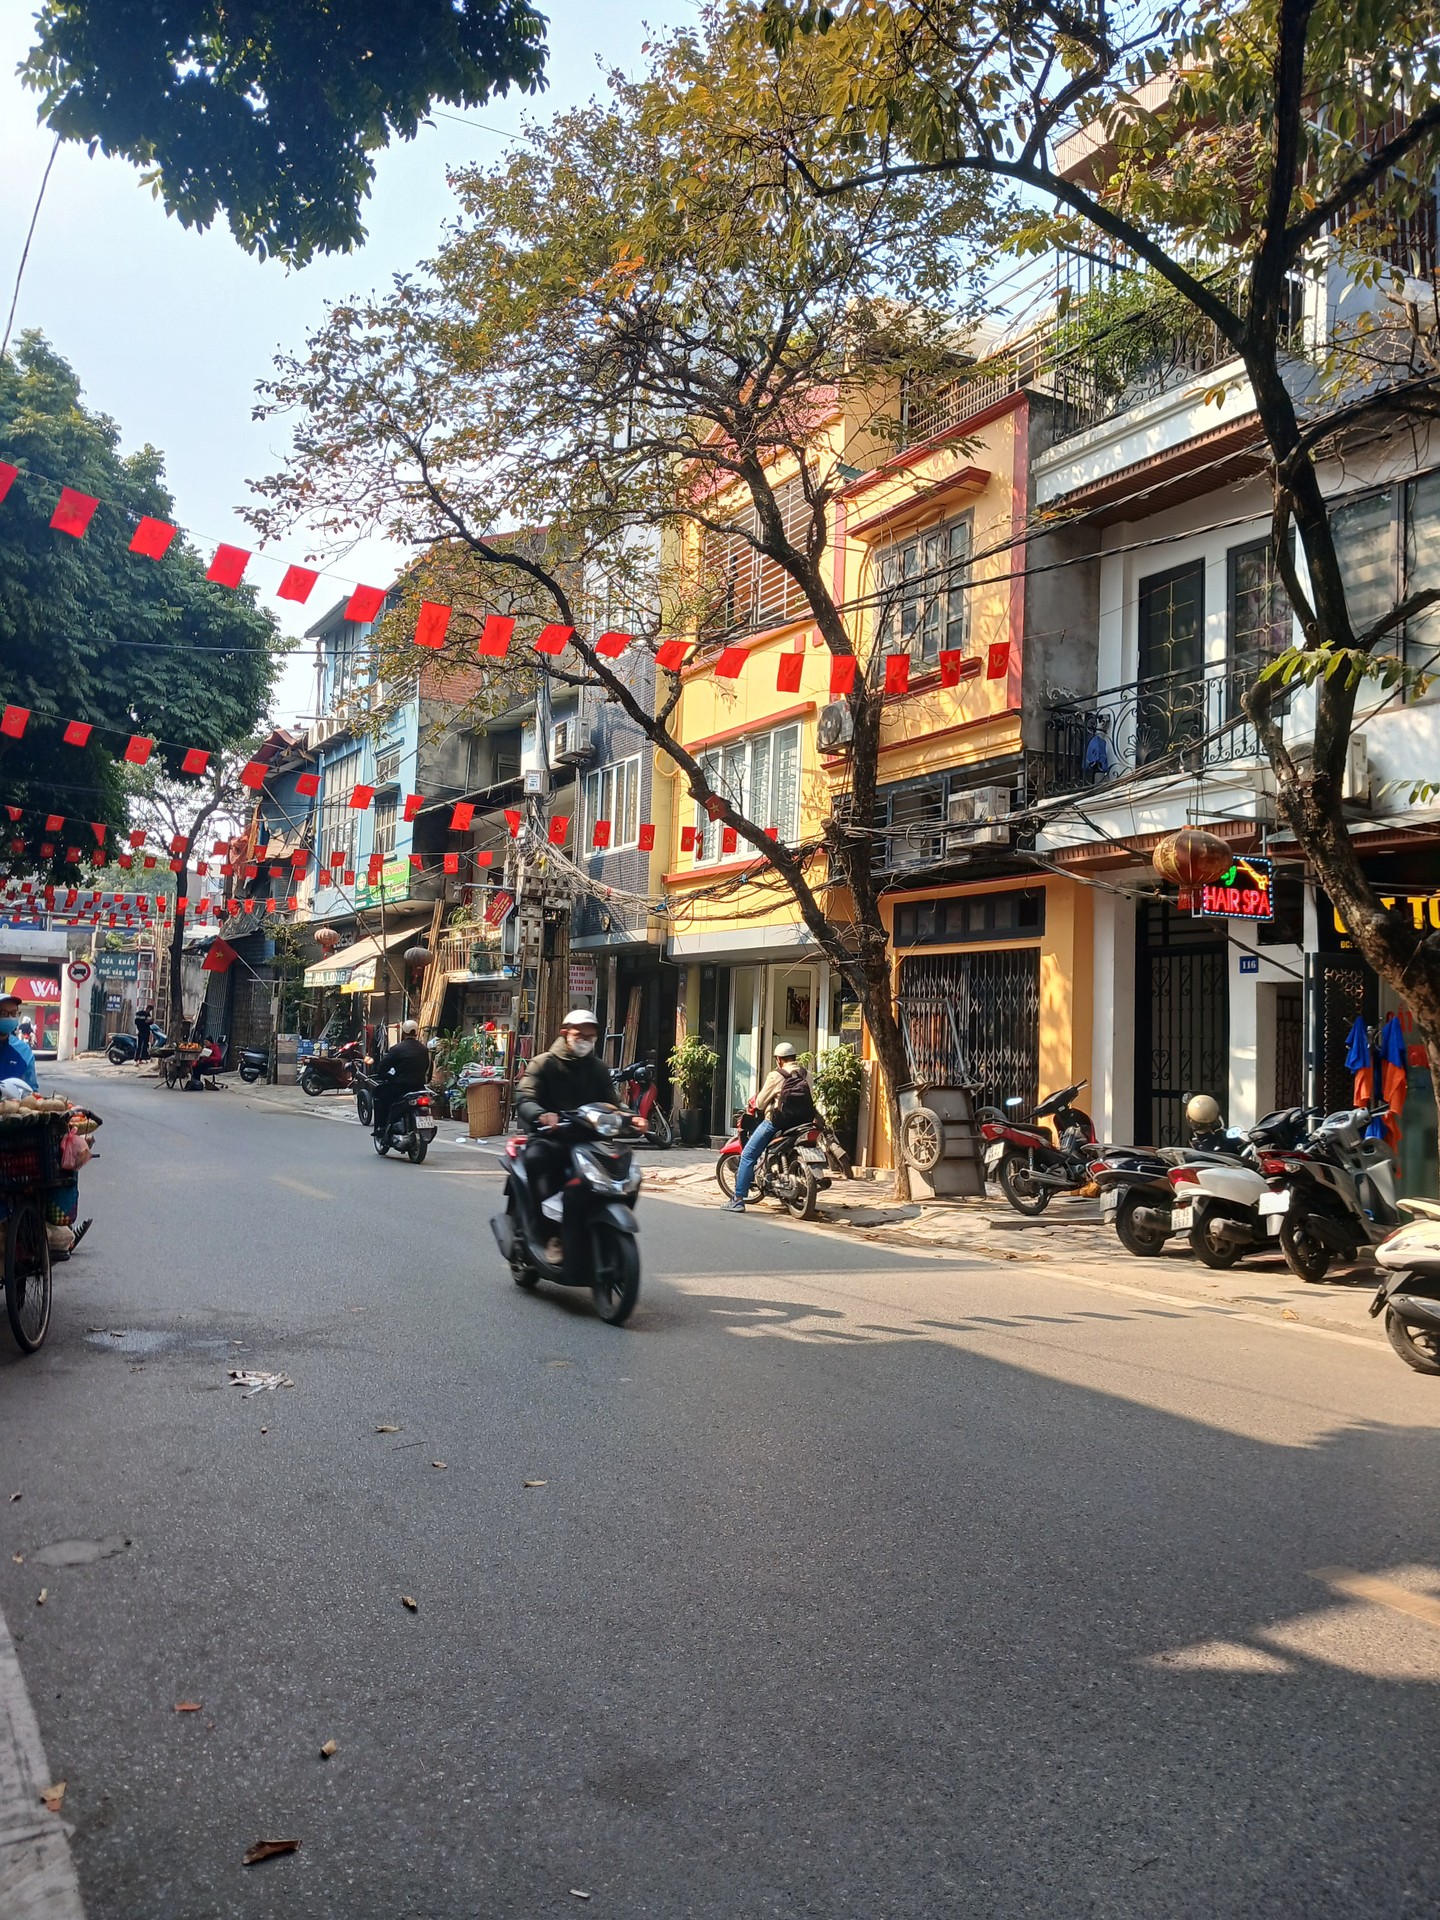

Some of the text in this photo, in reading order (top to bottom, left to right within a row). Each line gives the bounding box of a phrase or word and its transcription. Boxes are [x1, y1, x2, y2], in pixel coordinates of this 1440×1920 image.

[1205, 886, 1270, 915] HAIR SPA
[1242, 960, 1257, 970] 116
